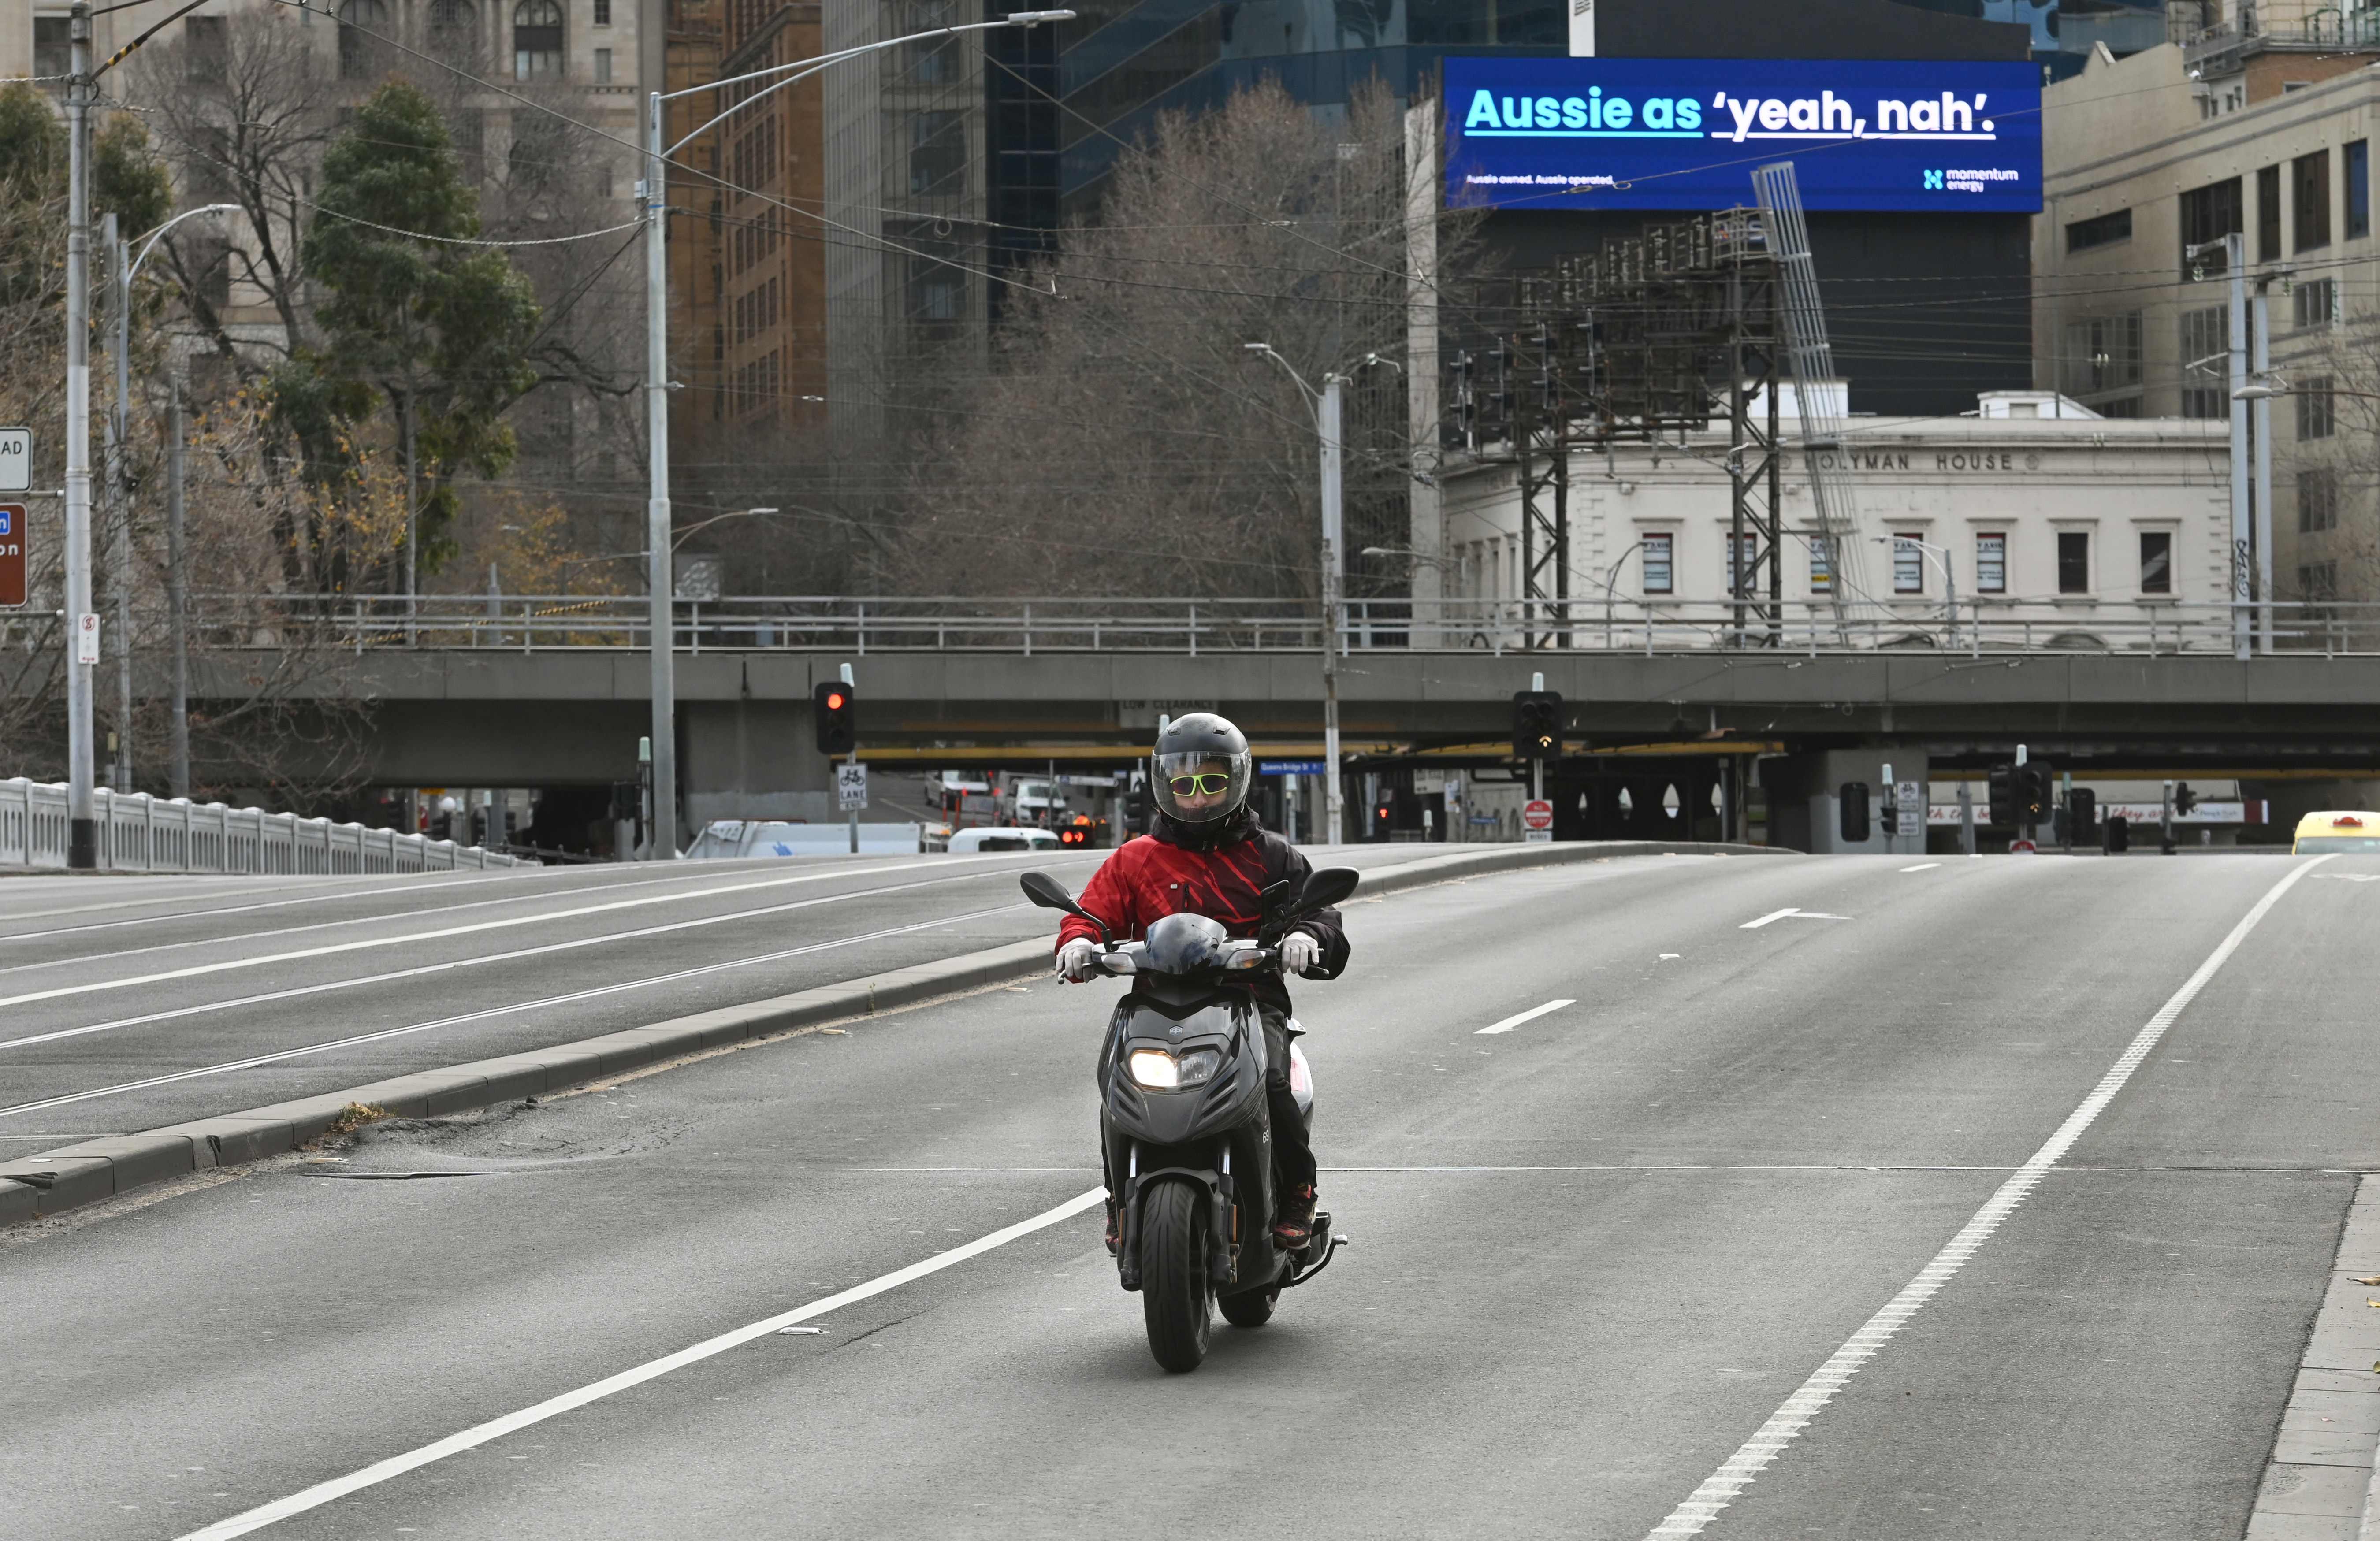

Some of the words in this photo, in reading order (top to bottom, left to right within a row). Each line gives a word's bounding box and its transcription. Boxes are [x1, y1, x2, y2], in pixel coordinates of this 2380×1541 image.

[1465, 86, 1633, 128] Aussie
[1642, 98, 1702, 129] as
[1535, 174, 1568, 184] Aussie
[1946, 168, 2019, 181] momentum
[1946, 181, 1984, 193] energy
[1937, 454, 2012, 471] HOUSE
[840, 791, 865, 800] LANE
[1263, 1129, 1269, 1144] 69
